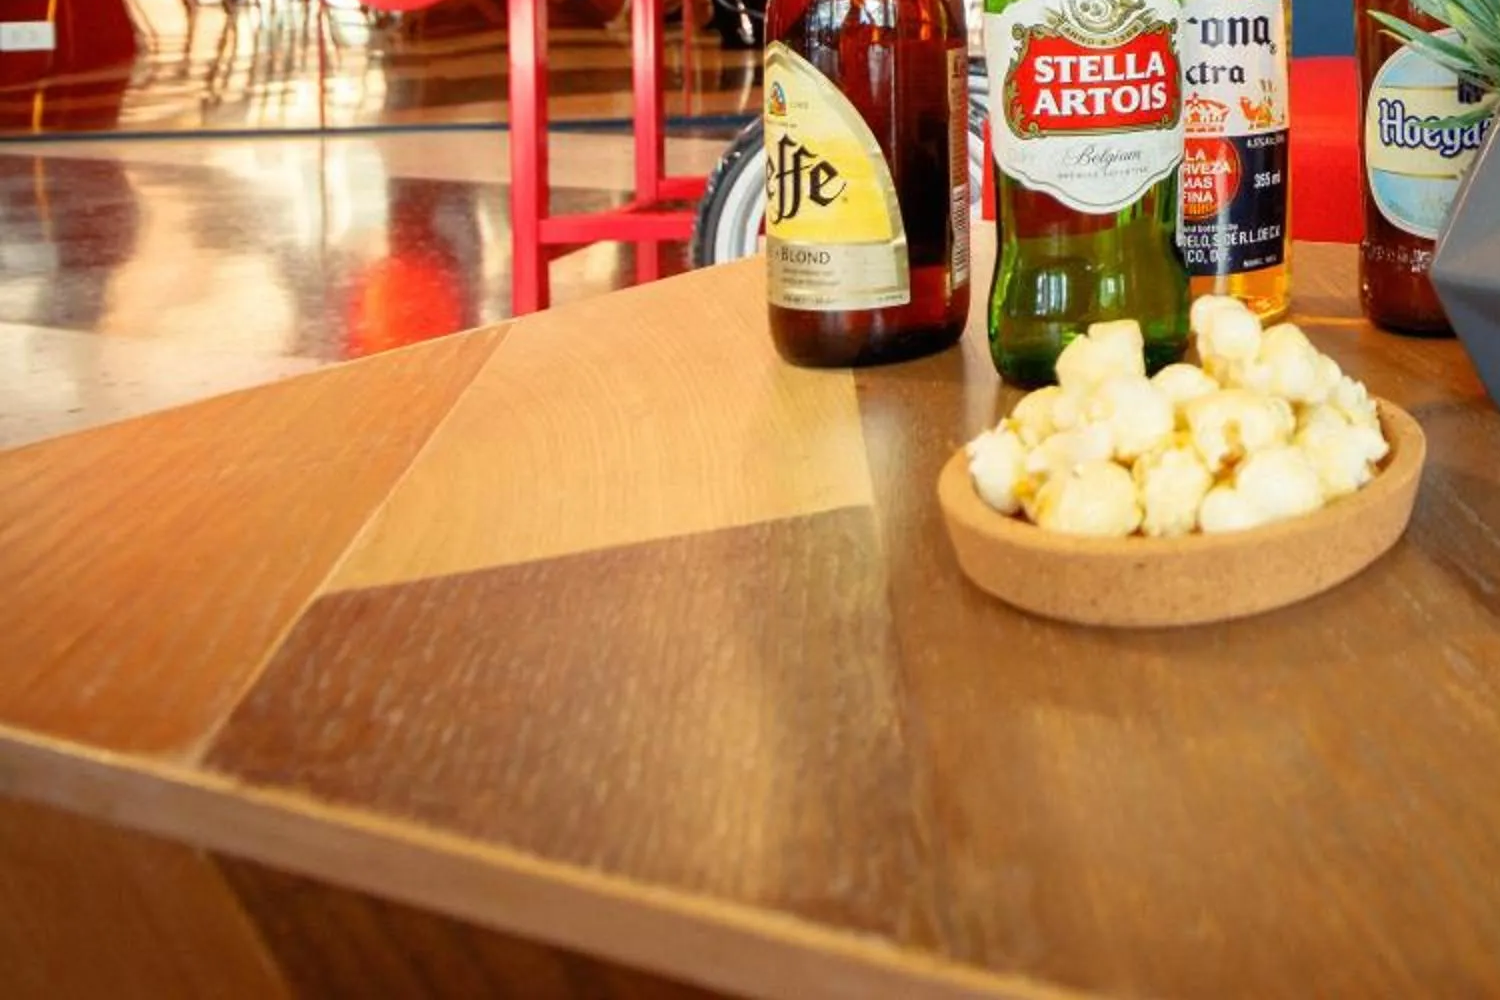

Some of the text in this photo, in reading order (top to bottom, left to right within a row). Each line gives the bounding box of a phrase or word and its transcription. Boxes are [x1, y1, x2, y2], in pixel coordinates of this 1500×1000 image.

[1186, 14, 1271, 48] ona
[1033, 51, 1165, 84] STELLA
[1032, 81, 1168, 116] ARTOIS
[1185, 148, 1207, 161] LA
[781, 247, 831, 266] BLOND
